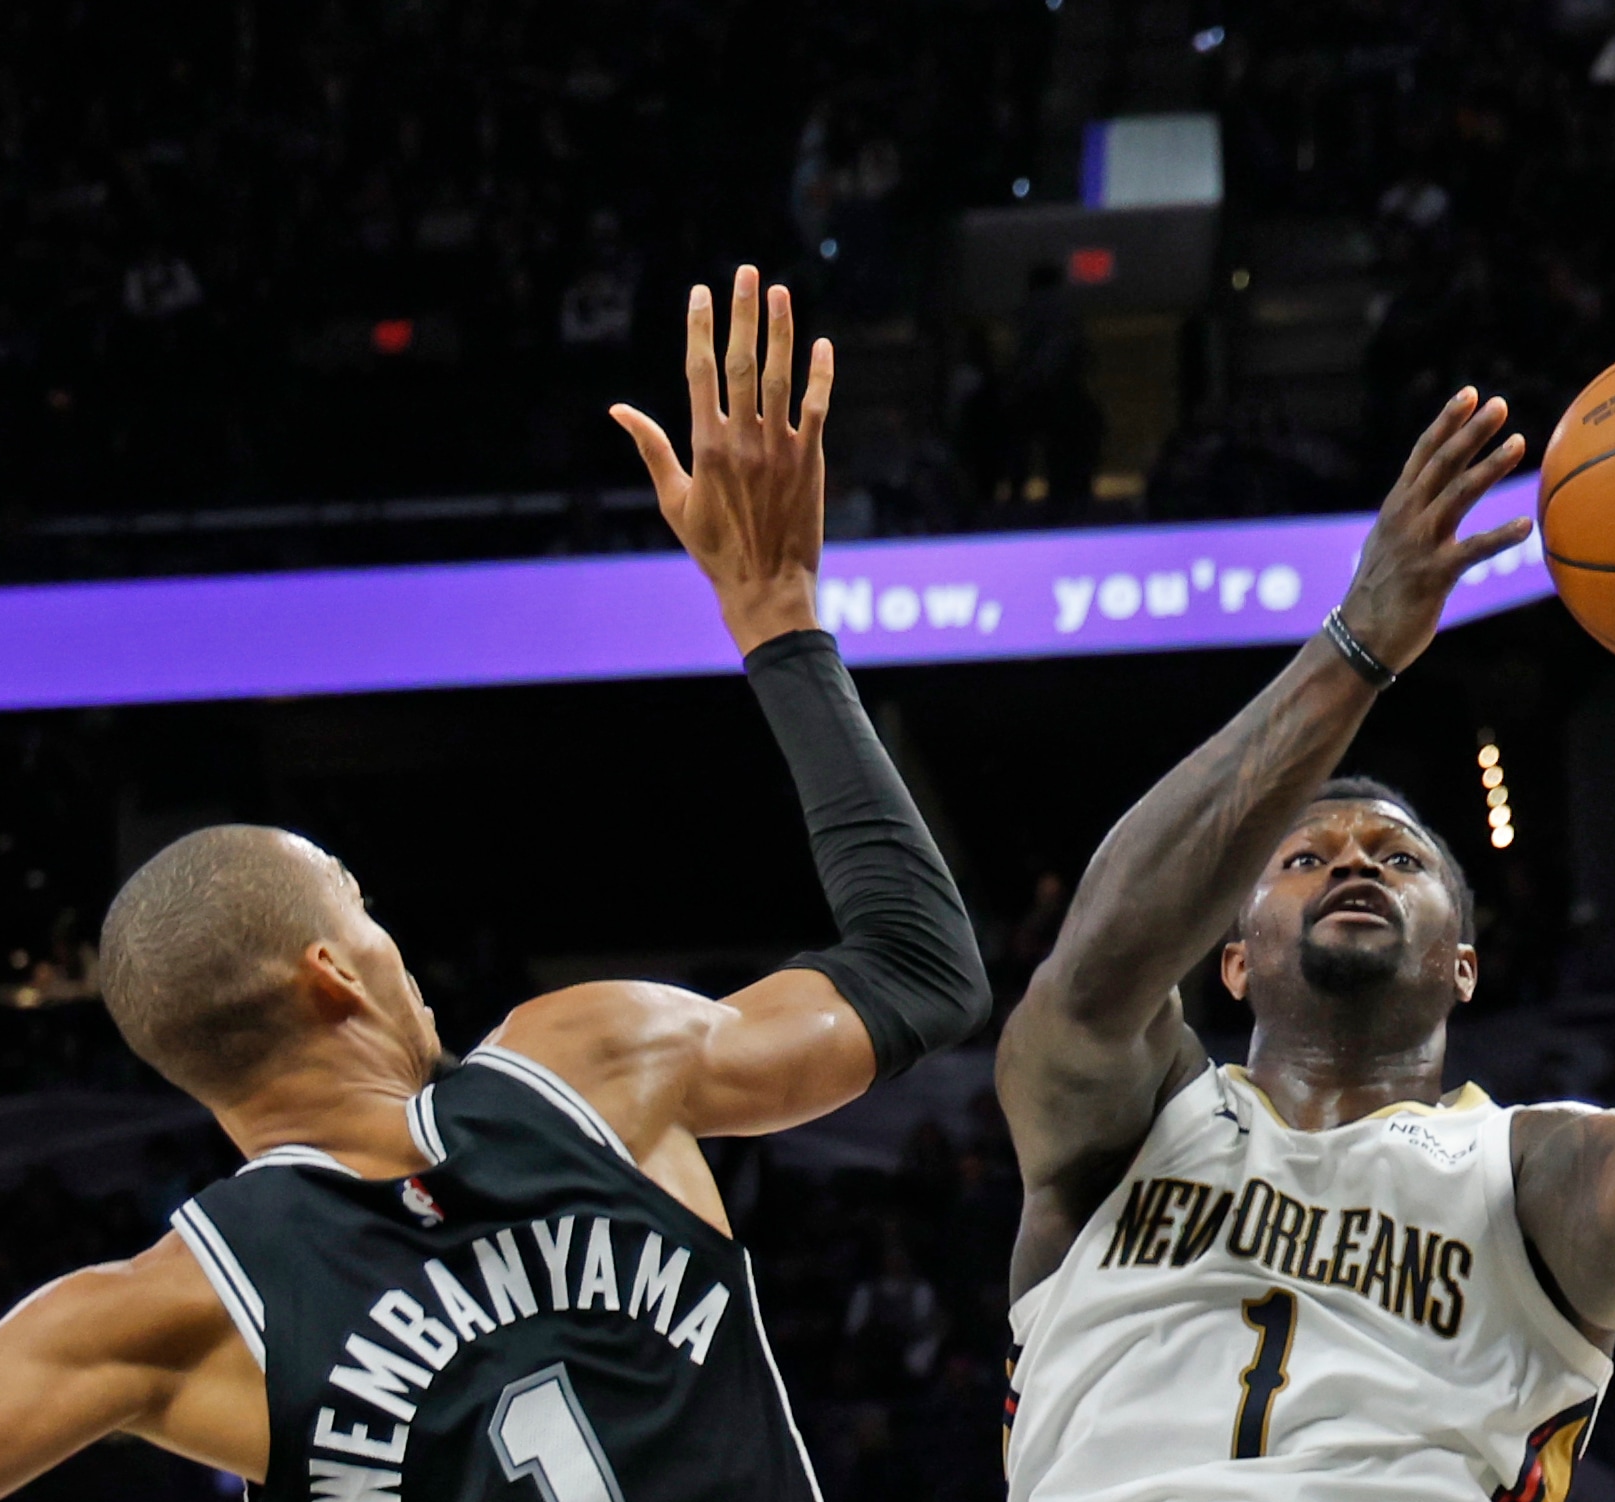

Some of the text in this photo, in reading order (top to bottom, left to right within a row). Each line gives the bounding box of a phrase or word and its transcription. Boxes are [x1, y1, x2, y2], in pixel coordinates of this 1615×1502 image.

[819, 556, 1302, 636] Now, you're
[1389, 1122, 1441, 1147] NEW
[1099, 1177, 1472, 1339] NEW ORLEANS
[1231, 1286, 1298, 1460] 1
